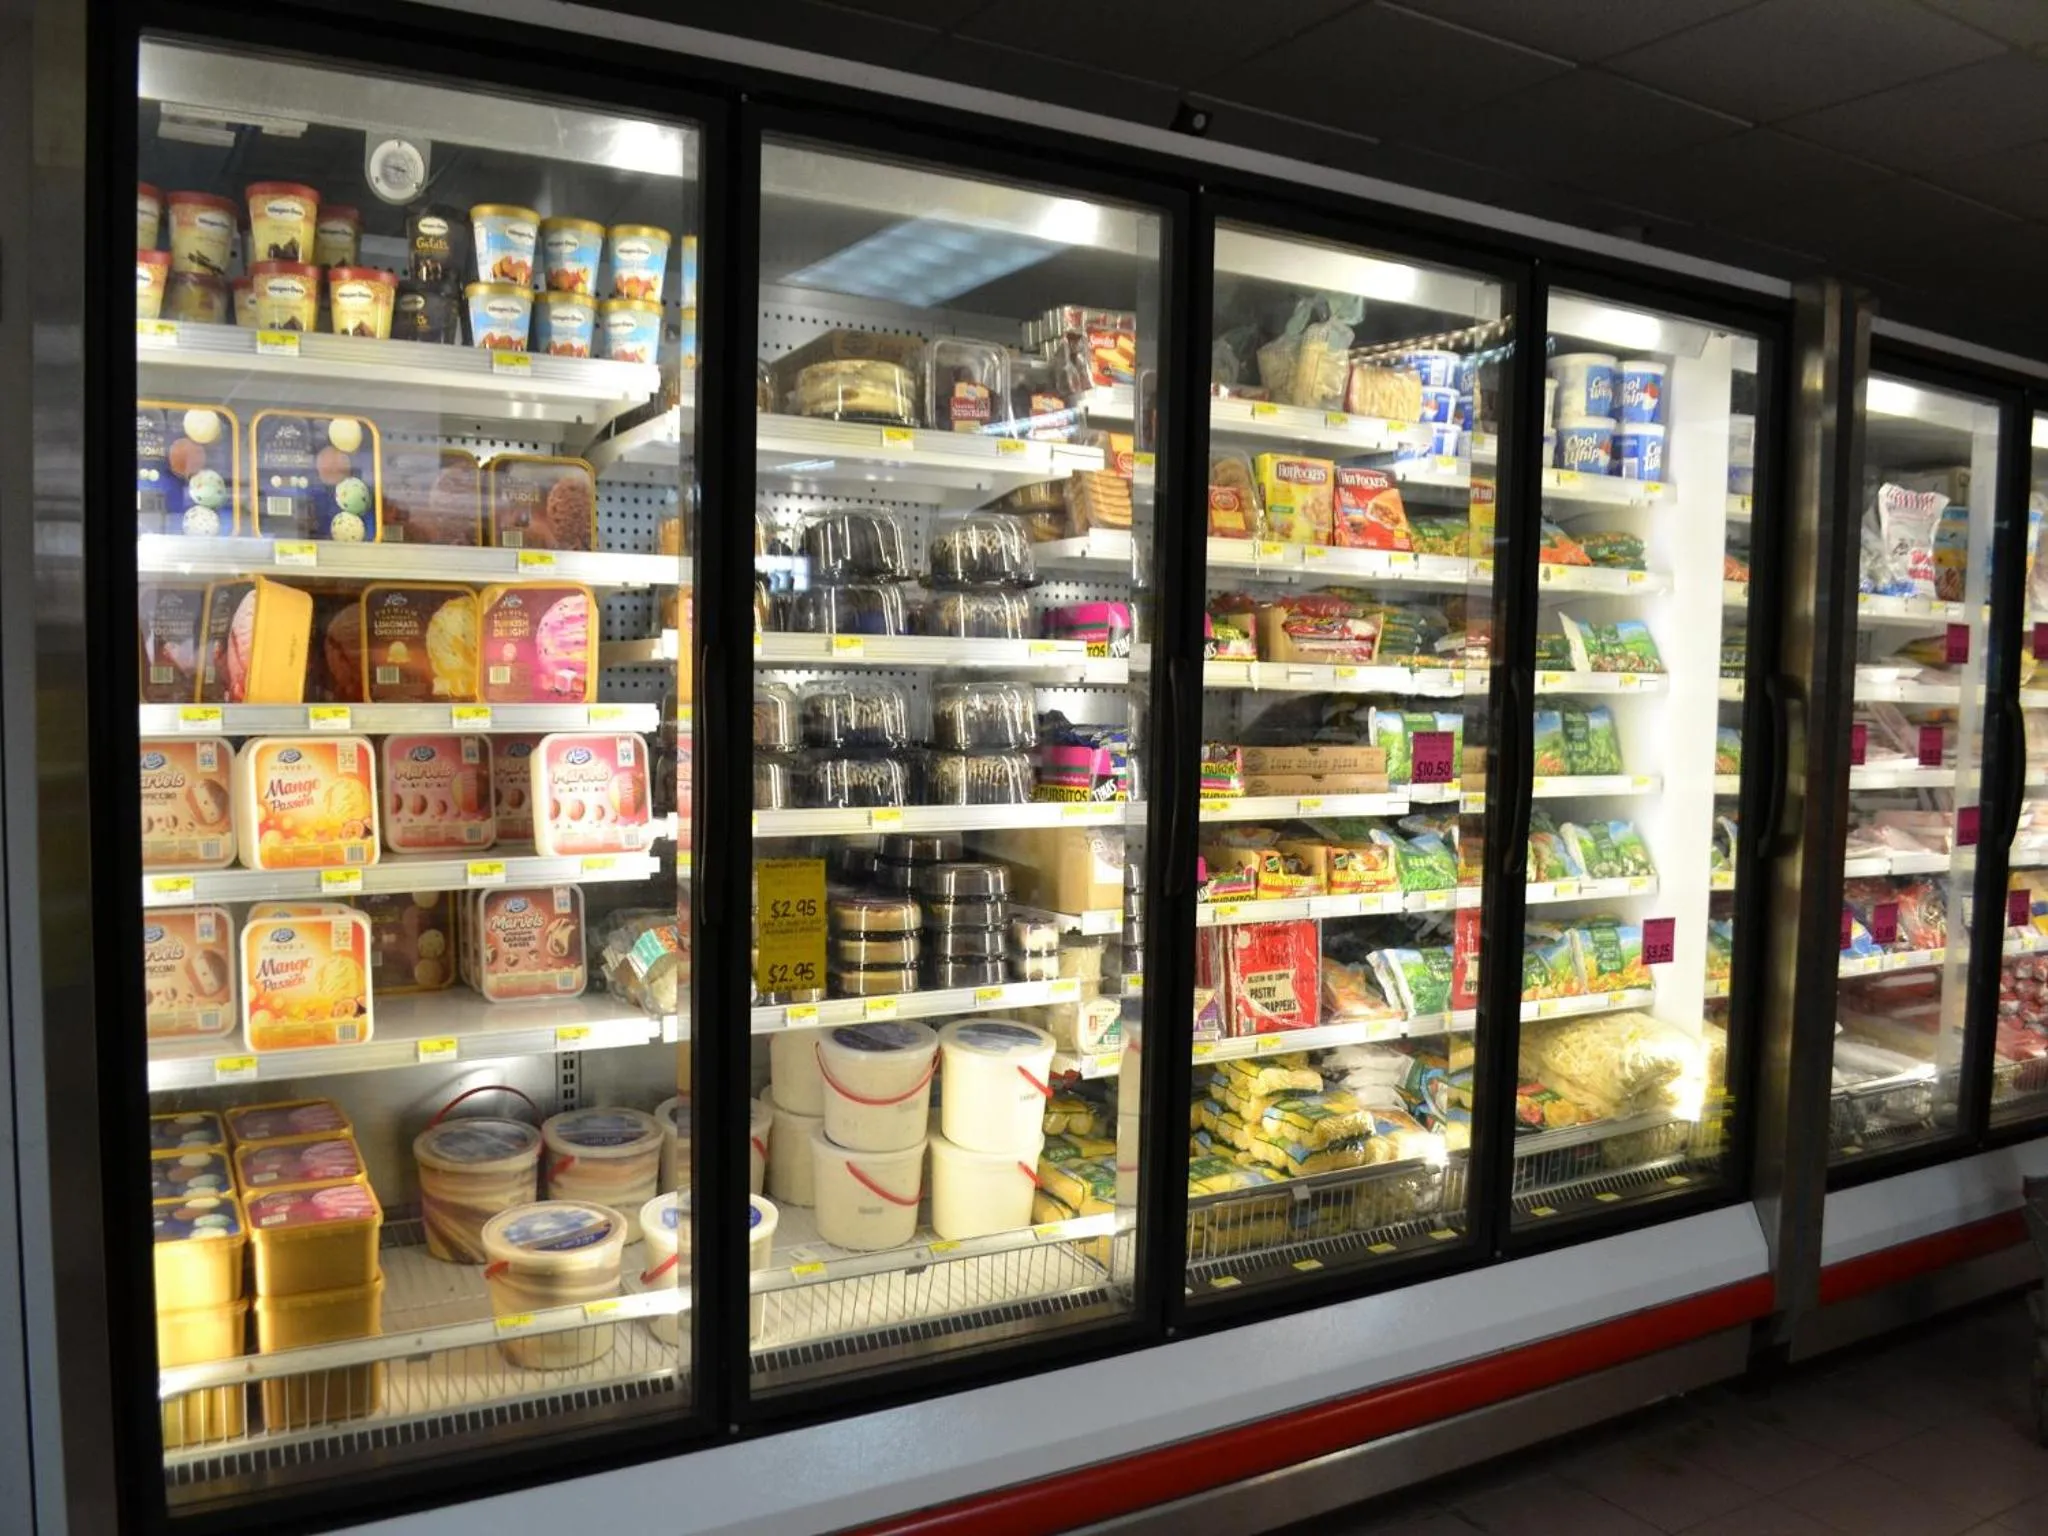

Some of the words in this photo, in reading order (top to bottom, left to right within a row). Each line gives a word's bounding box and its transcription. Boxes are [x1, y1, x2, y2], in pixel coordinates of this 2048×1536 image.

[1566, 432, 1597, 450] Cool
[1564, 444, 1601, 467] Whip
[265, 778, 321, 800] Mango
[770, 899, 817, 919] $2.95
[256, 957, 313, 979] Mango
[768, 963, 816, 985] $2.95
[1250, 986, 1276, 999] PASTRY
[1263, 999, 1296, 1012] RAPPERS
